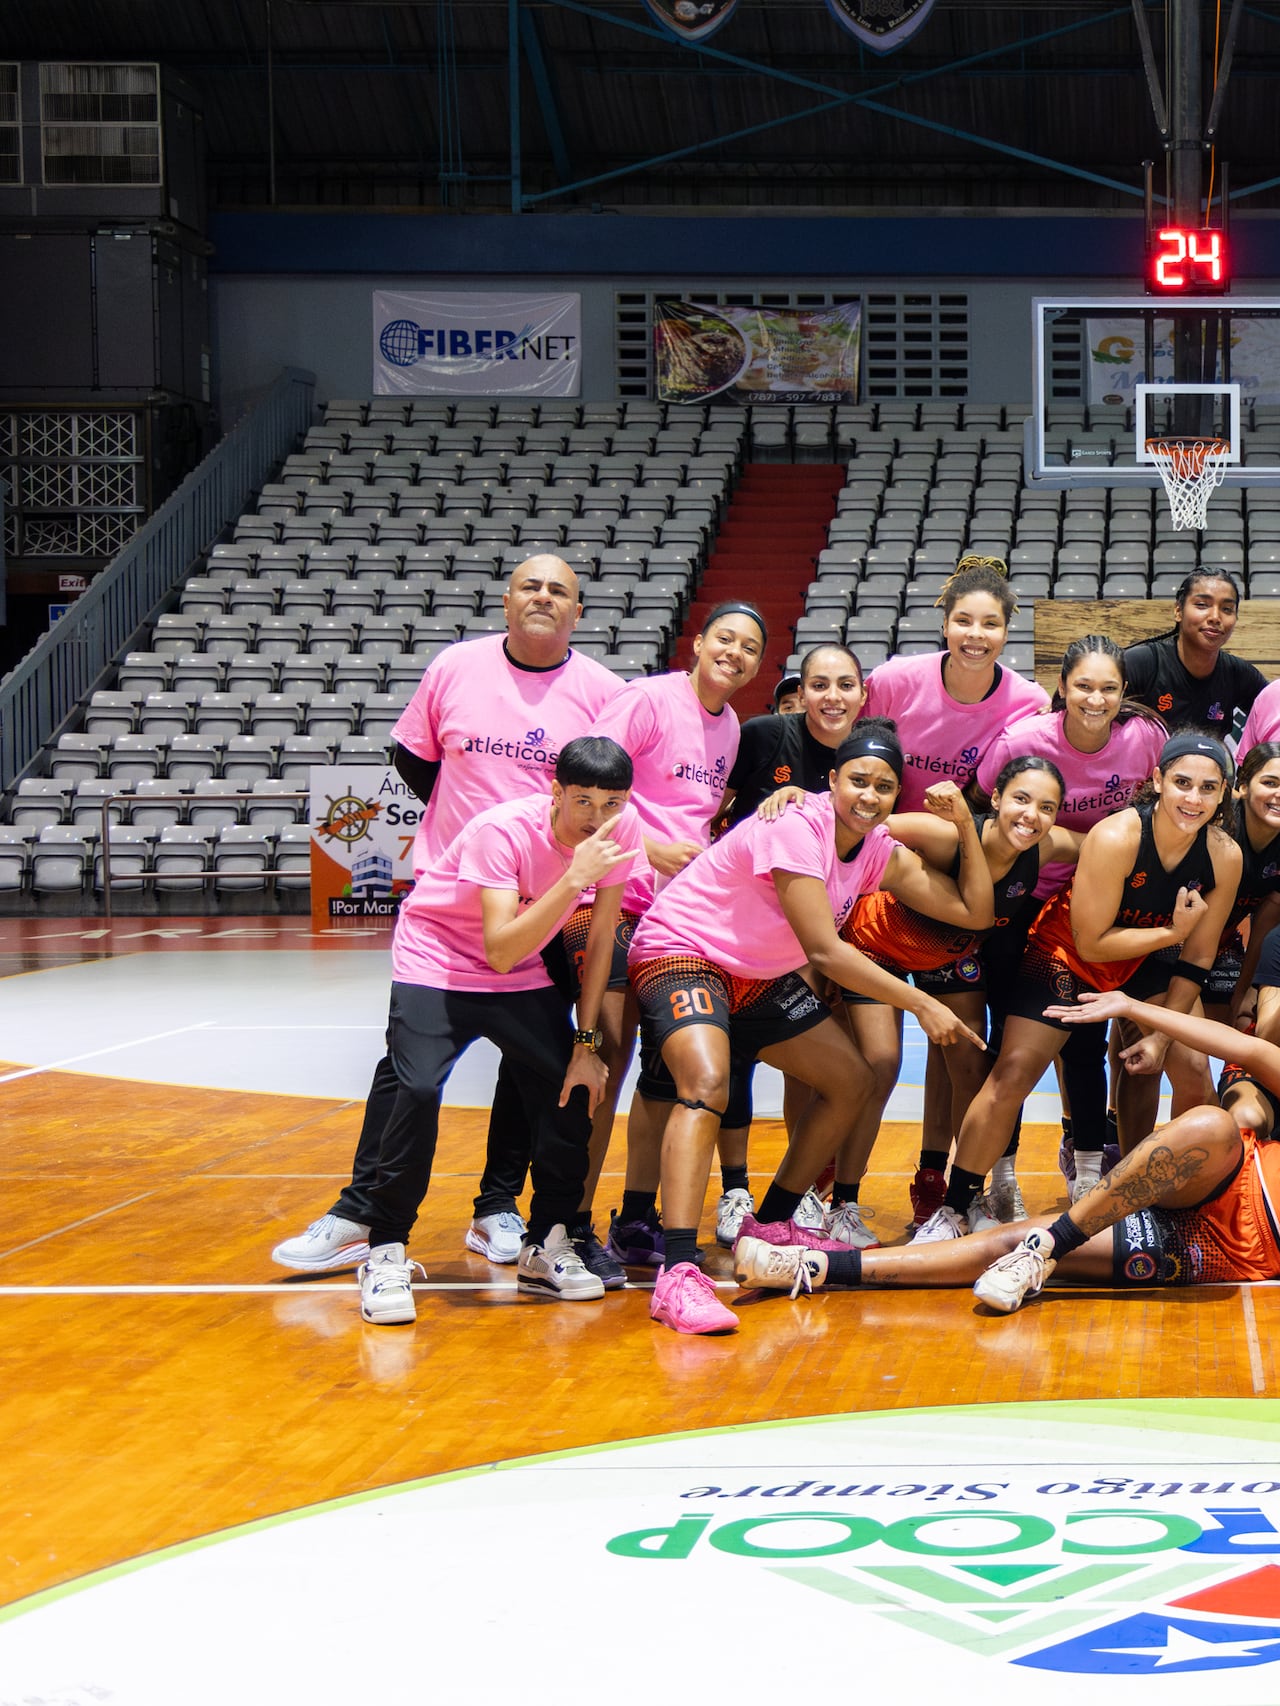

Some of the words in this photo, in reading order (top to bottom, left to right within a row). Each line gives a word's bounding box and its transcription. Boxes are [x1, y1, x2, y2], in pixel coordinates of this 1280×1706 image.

[1156, 231, 1221, 286] 24
[786, 393, 806, 401] 597
[524, 727, 546, 747] 50
[461, 736, 560, 766] atléticas
[672, 762, 729, 791] atlética
[903, 753, 977, 780] atlética
[378, 771, 418, 801] Áng
[1059, 787, 1133, 813] tléticas
[363, 901, 394, 915] Mar
[0, 928, 391, 939] ARES
[669, 987, 715, 1021] 20
[680, 1480, 1010, 1501] Siempre
